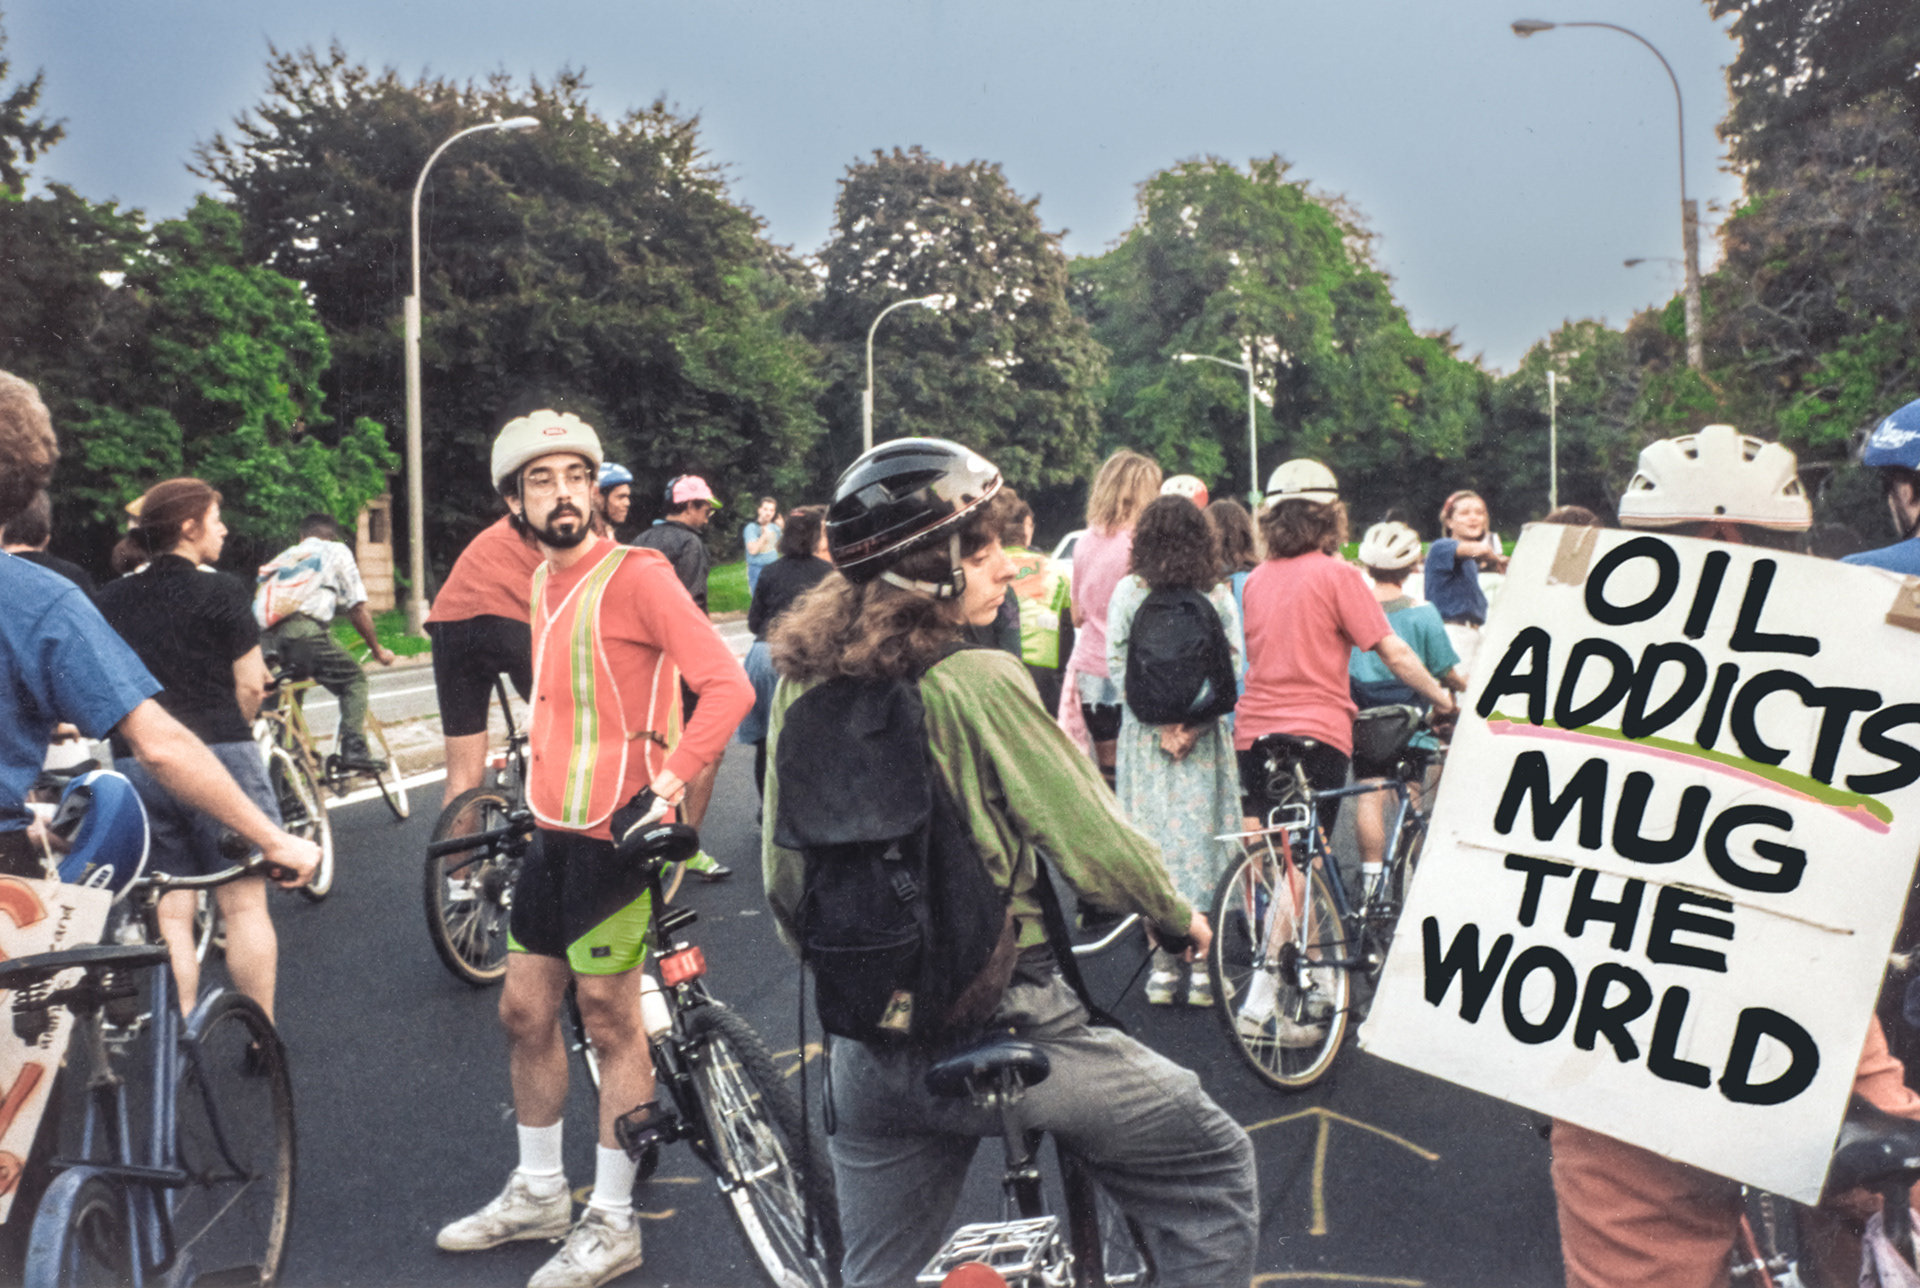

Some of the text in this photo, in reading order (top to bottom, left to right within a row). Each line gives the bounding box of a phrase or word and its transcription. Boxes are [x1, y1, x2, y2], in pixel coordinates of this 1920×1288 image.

[1584, 536, 1821, 658] OIL
[1475, 626, 1920, 795] ADDICTS
[1494, 750, 1807, 894] MUG
[1504, 853, 1735, 973] THE
[1422, 916, 1820, 1106] WORLD
